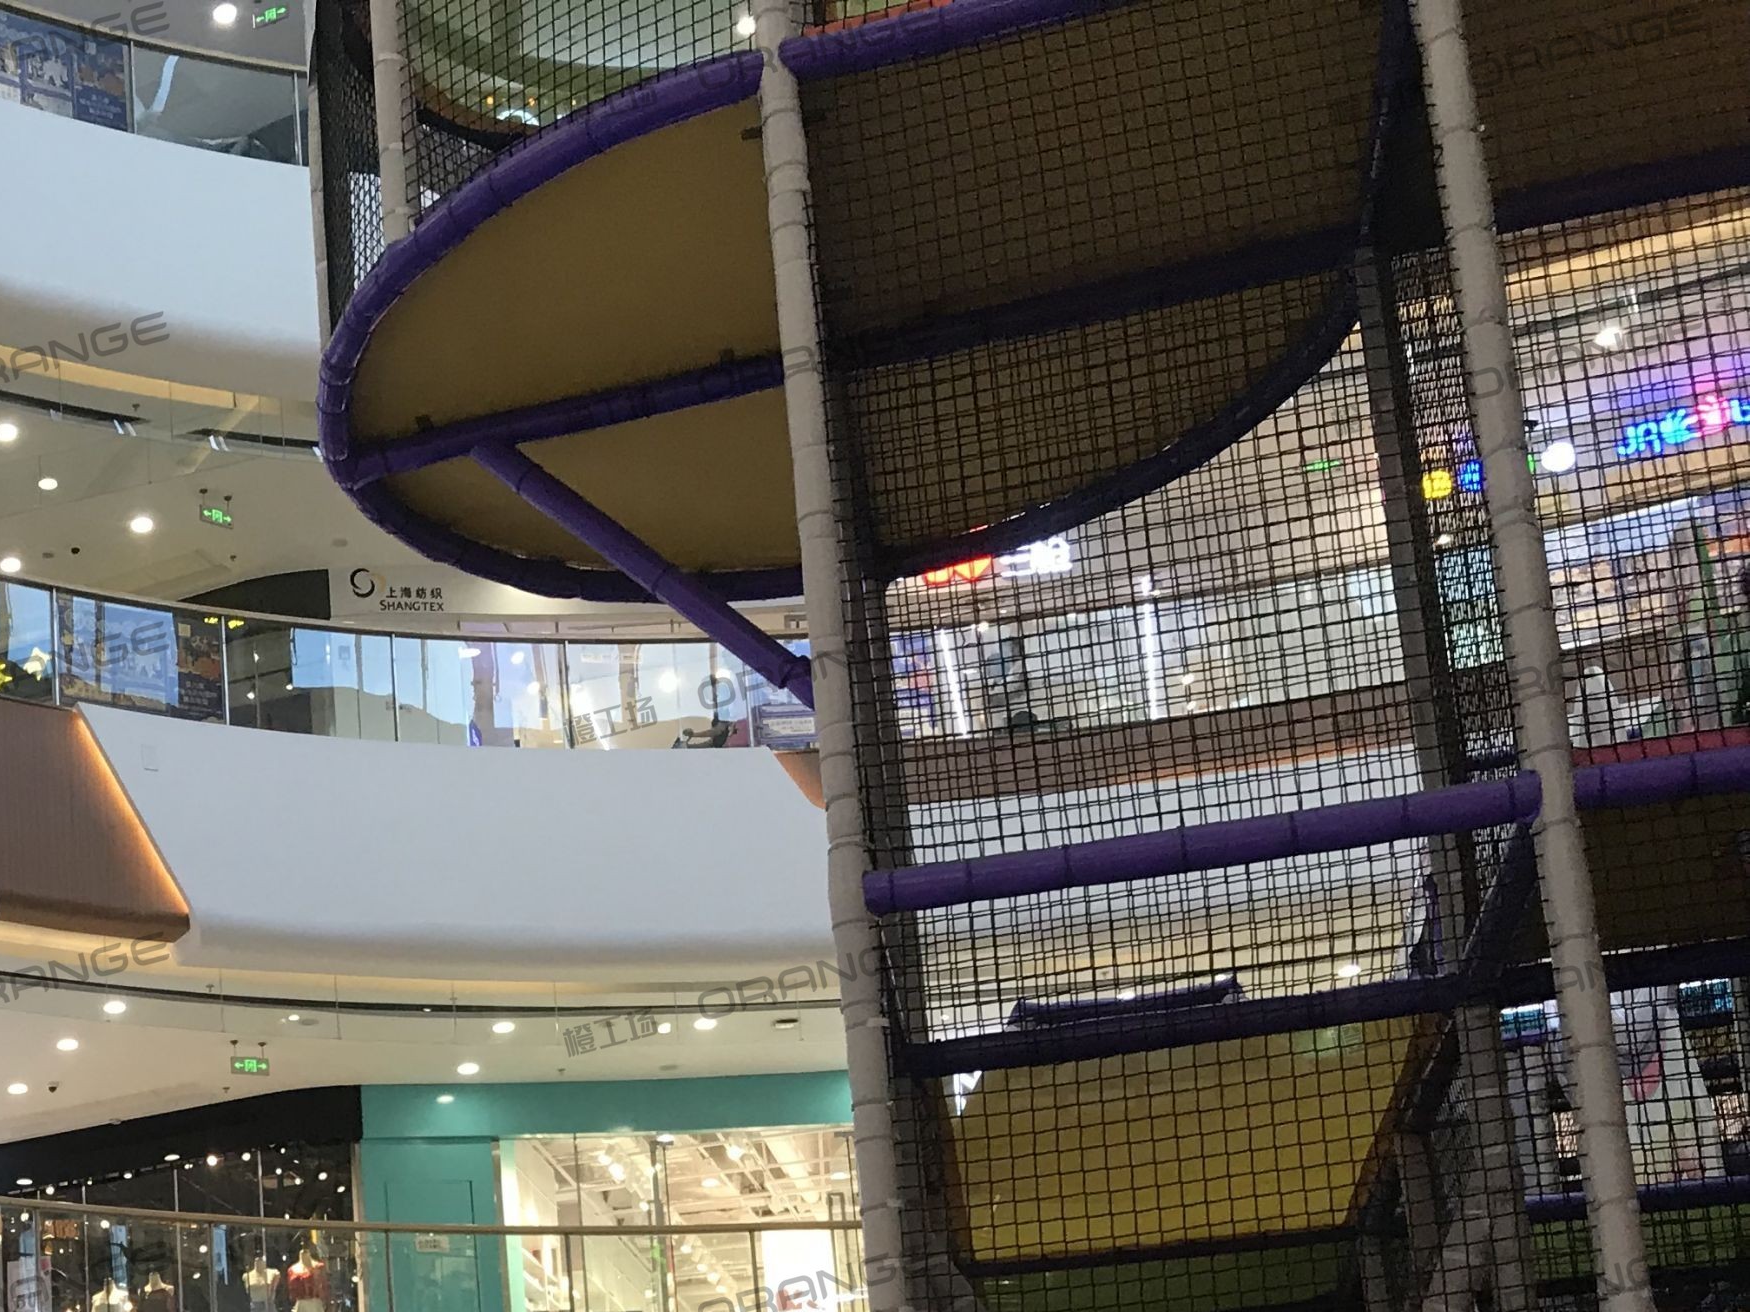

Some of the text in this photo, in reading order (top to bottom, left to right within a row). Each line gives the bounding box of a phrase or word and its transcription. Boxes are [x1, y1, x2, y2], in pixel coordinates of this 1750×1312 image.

[385, 586, 443, 600] 上海纺织
[379, 599, 445, 612] SHANGTEX
